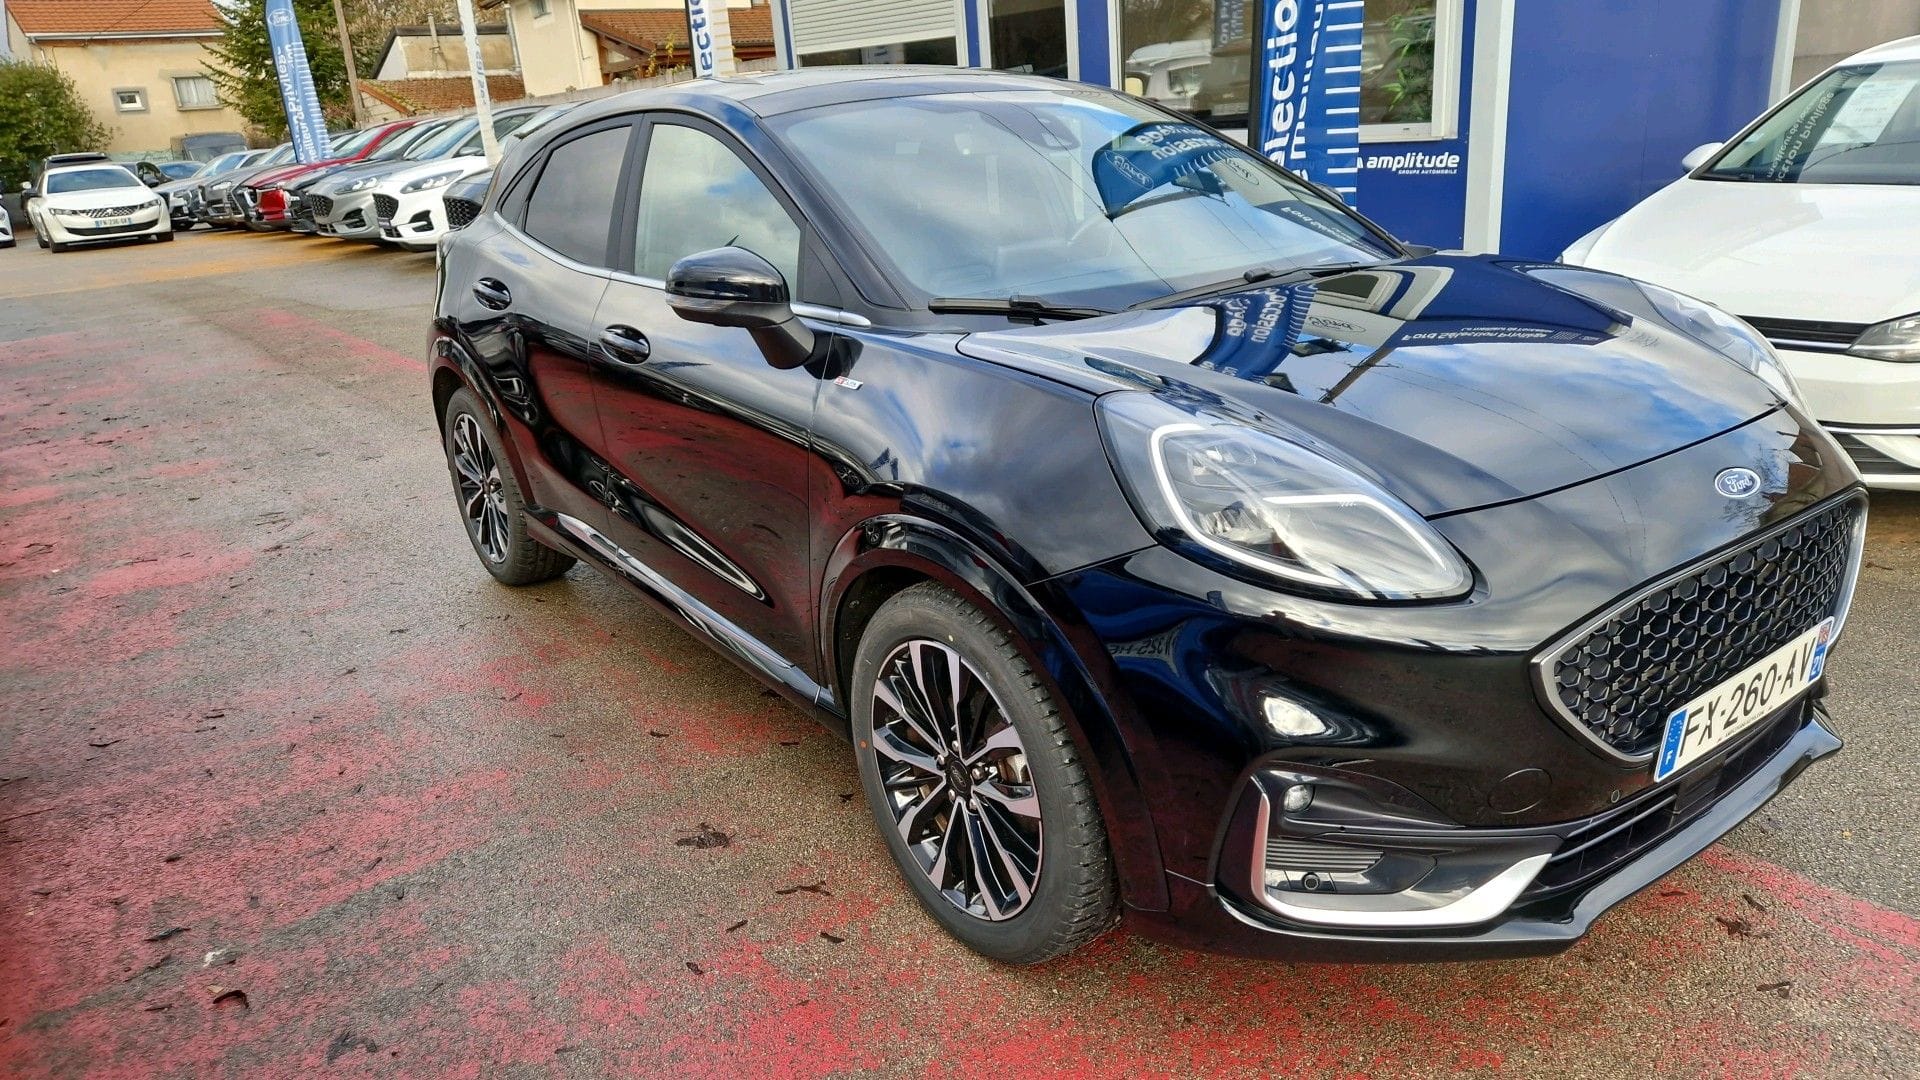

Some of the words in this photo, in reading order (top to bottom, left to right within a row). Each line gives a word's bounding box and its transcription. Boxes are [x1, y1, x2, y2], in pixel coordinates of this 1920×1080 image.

[1366, 152, 1460, 171] amplitude
[1725, 474, 1753, 493] Ford
[1811, 652, 1824, 676] 21
[1678, 636, 1816, 758] FX-260-AV
[1664, 751, 1673, 764] F
